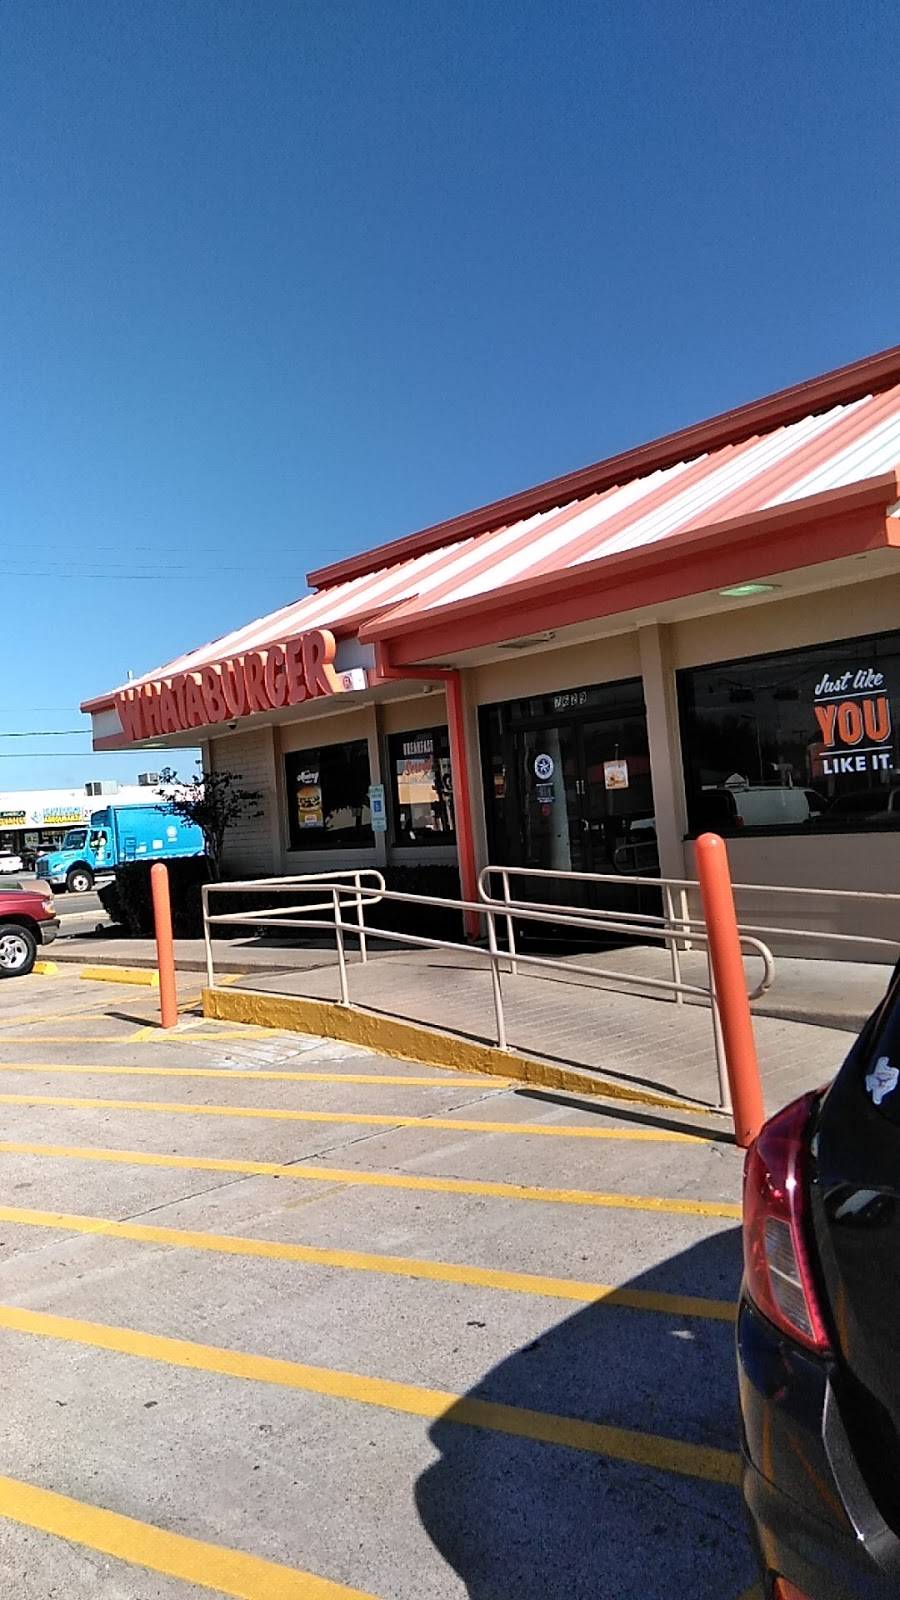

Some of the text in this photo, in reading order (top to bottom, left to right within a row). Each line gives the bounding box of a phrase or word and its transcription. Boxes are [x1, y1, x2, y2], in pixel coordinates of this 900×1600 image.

[115, 629, 337, 741] WHATABURGER
[815, 668, 884, 695] Just like
[814, 697, 892, 747] YOU
[403, 739, 434, 756] BREAKFAST
[822, 753, 894, 775] LIKE IT.
